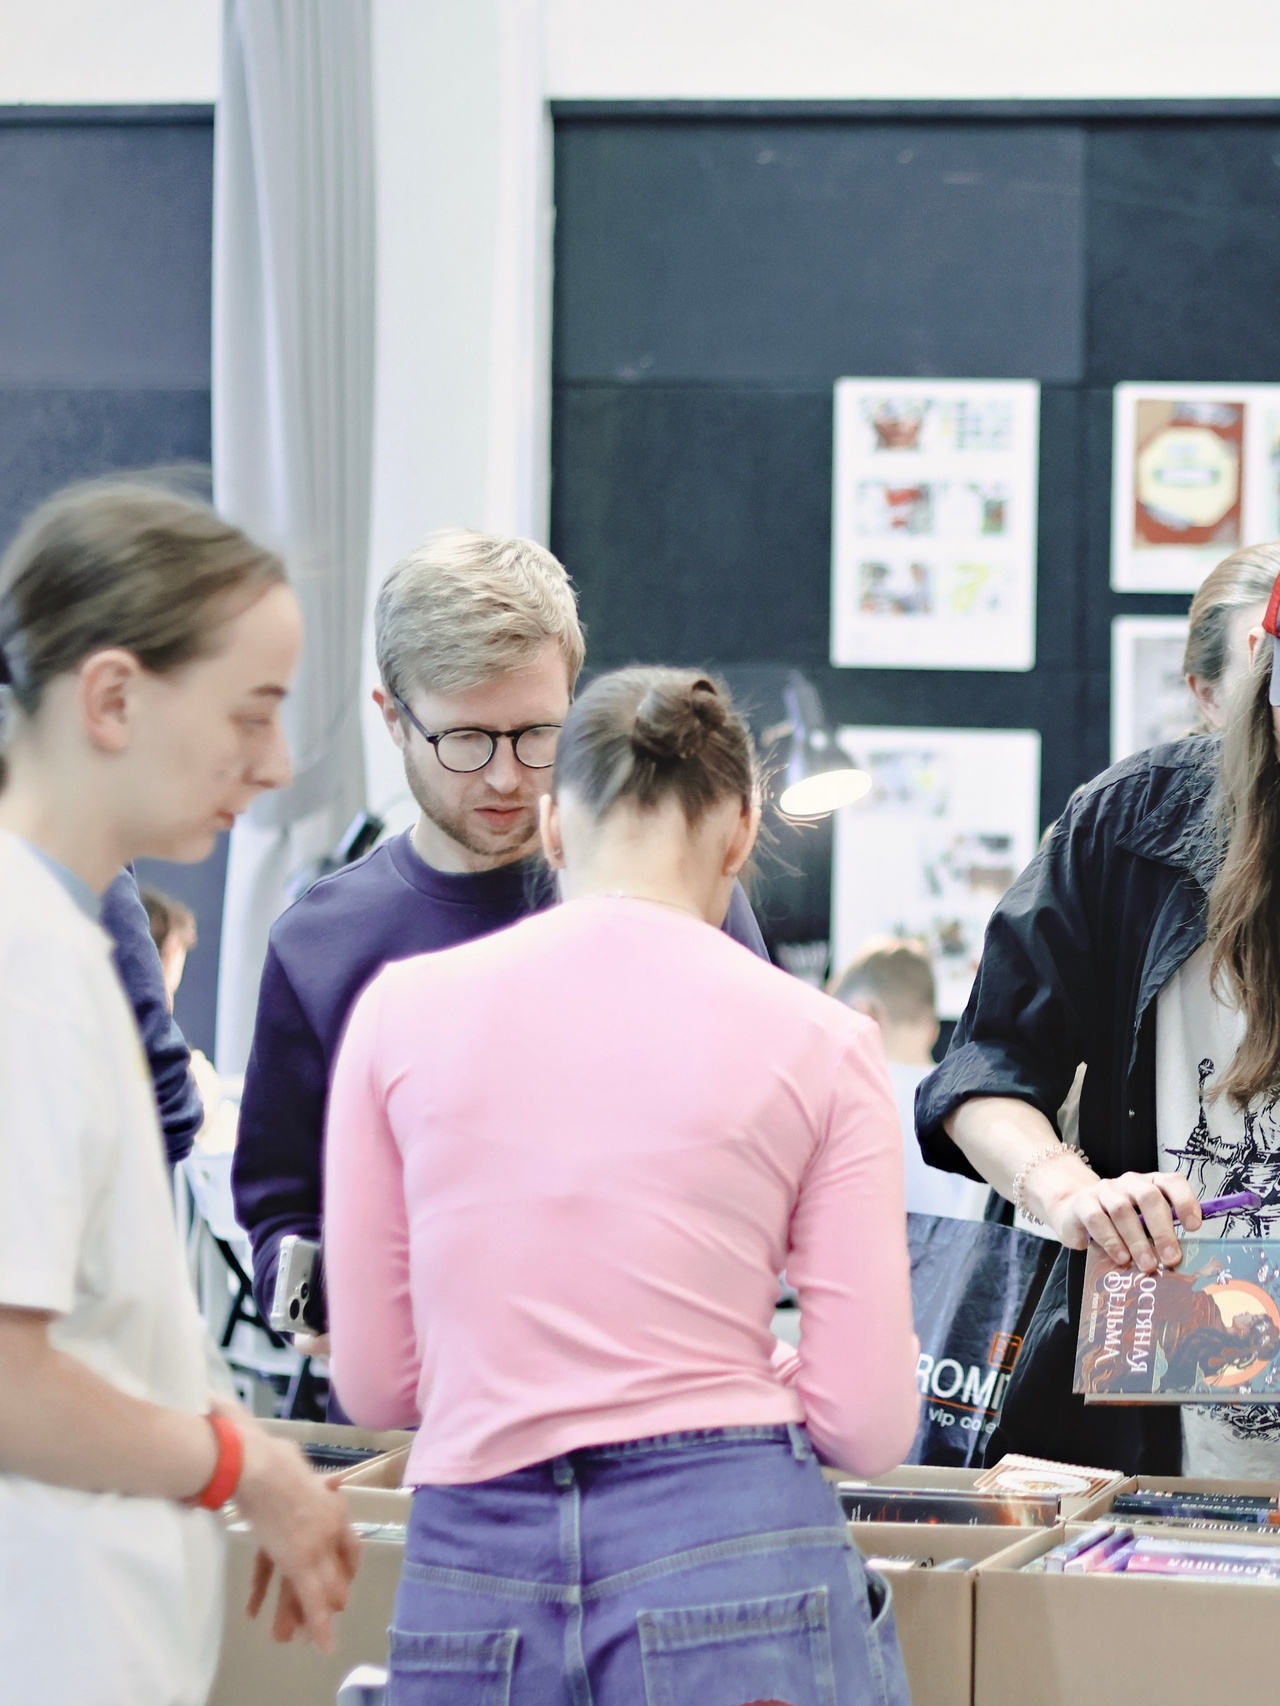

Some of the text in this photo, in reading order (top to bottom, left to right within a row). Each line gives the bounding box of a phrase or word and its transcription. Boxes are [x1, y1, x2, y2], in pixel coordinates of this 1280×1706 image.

[1095, 1271, 1133, 1369] ВЕДЬМА
[1126, 1265, 1162, 1373] ОСТЯНАЯ
[929, 1407, 956, 1428] vip
